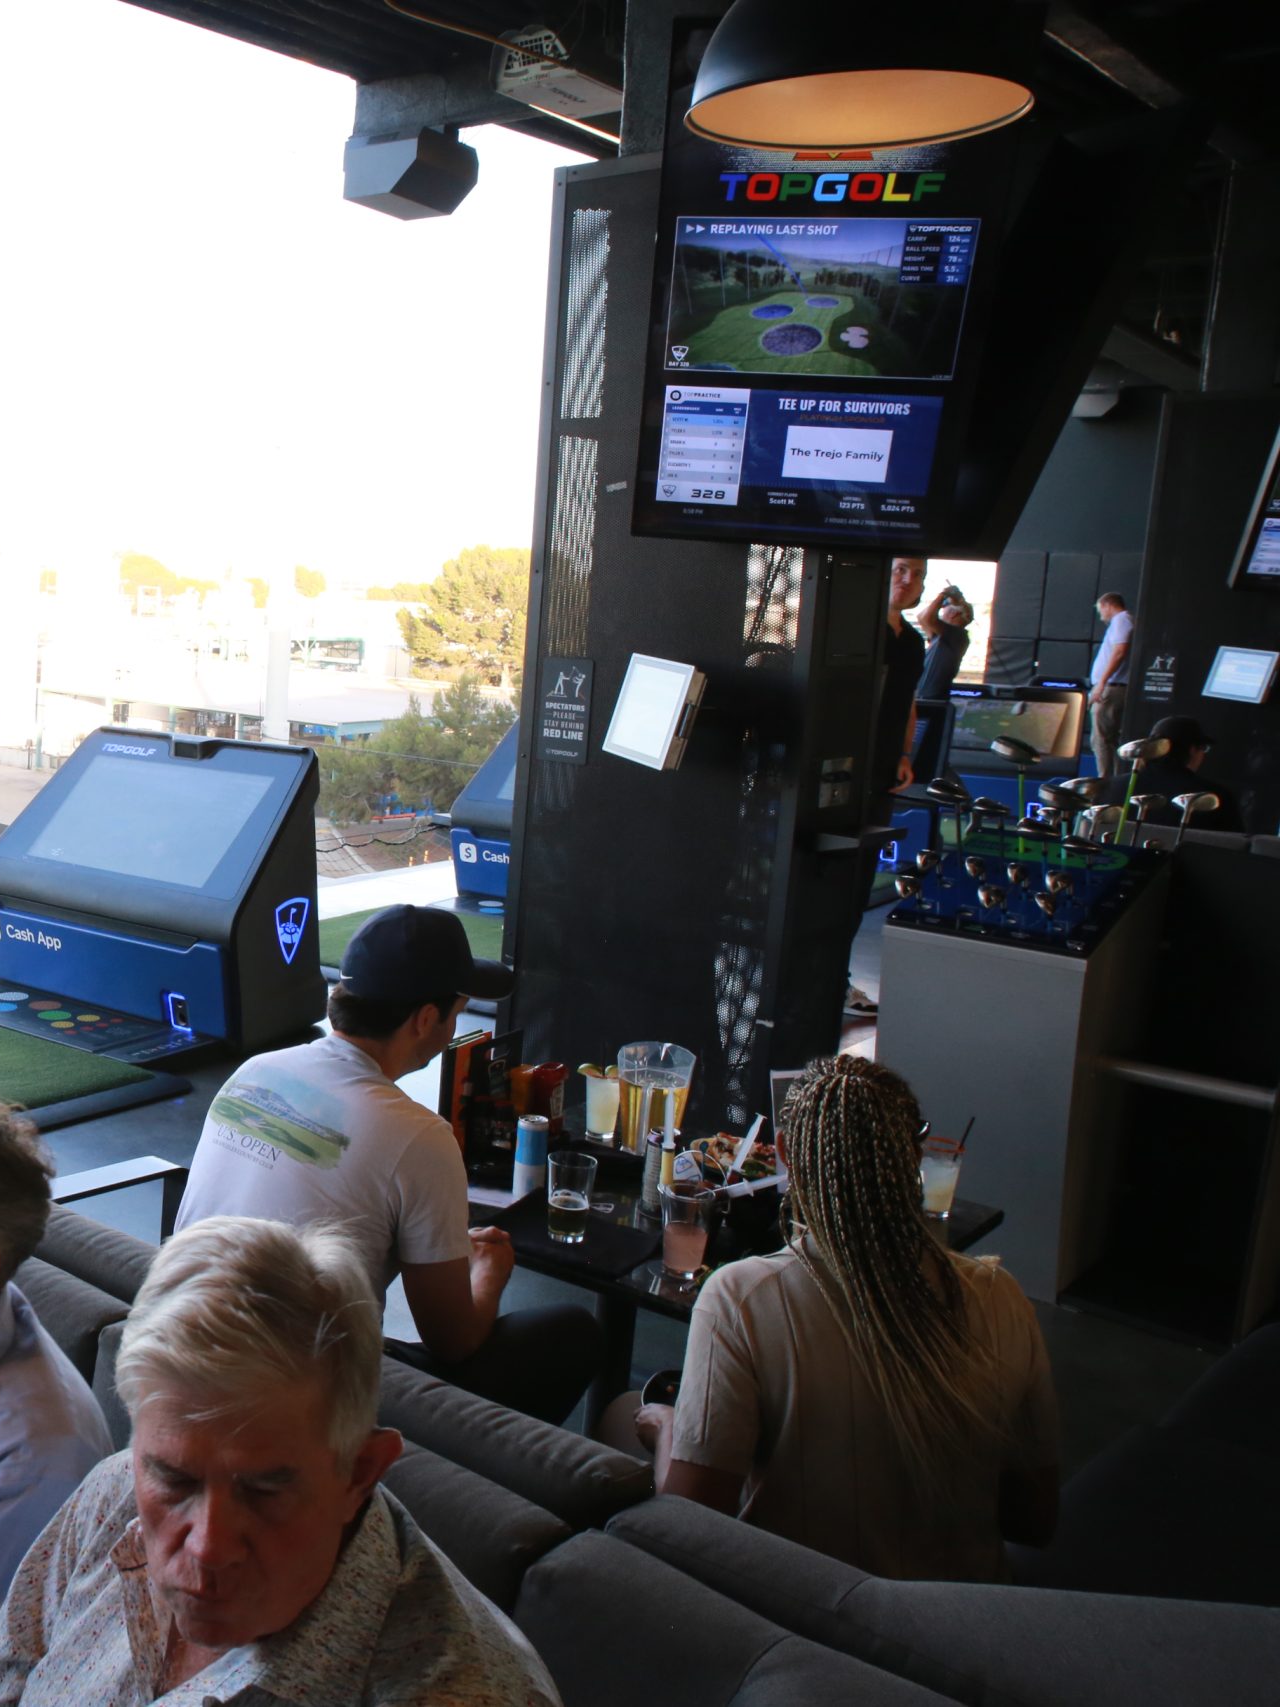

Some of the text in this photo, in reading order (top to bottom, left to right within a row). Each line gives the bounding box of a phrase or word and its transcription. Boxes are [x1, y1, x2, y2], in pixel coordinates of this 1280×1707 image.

[719, 172, 947, 202] TOPGOLF
[710, 223, 838, 235] REPLAYING LAST SHOT
[778, 398, 911, 415] TEE UP FOR SURVIVORS
[790, 447, 884, 462] The Trejo Family
[690, 488, 726, 500] 328
[768, 497, 787, 506] Scott
[851, 502, 865, 510] PTS
[900, 505, 915, 513] PTS
[545, 701, 585, 712] SPECTATORS
[552, 710, 576, 720] PLEASE
[543, 719, 585, 730] STAY BEHIND
[543, 728, 584, 741] RED LINE
[101, 743, 157, 757] TOPGOLF
[551, 748, 579, 757] TOPGOLF
[482, 850, 510, 865] Cash
[5, 924, 35, 943] Cash
[37, 930, 62, 951] App
[217, 1123, 282, 1162] U.S. OPEN
